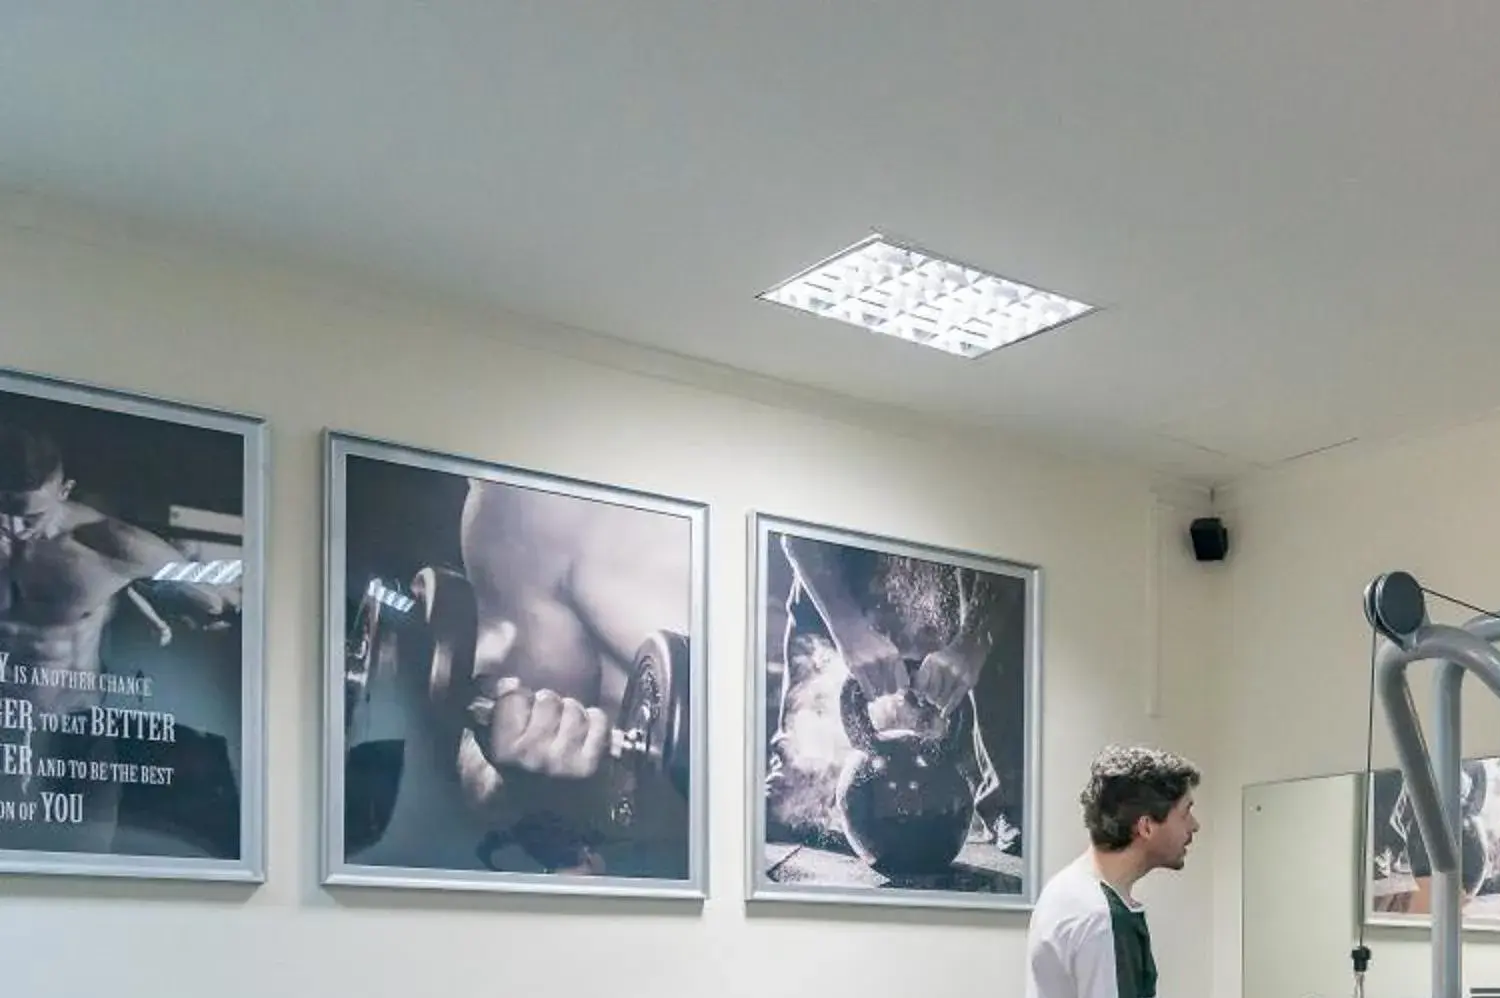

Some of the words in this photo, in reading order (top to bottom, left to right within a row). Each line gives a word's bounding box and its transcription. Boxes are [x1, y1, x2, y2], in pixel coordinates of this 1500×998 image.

[14, 664, 27, 685] IS
[31, 667, 96, 691] ANOTHER
[99, 673, 153, 697] CHANCE
[40, 713, 58, 733] TO
[61, 714, 88, 736] EAT
[90, 705, 176, 743] BETTER
[37, 757, 66, 778] AND
[68, 759, 87, 780] TO
[90, 761, 109, 781] BE
[111, 763, 139, 783] THE
[141, 766, 175, 785] BEST
[19, 801, 37, 821] OF
[40, 791, 84, 823] YOU
